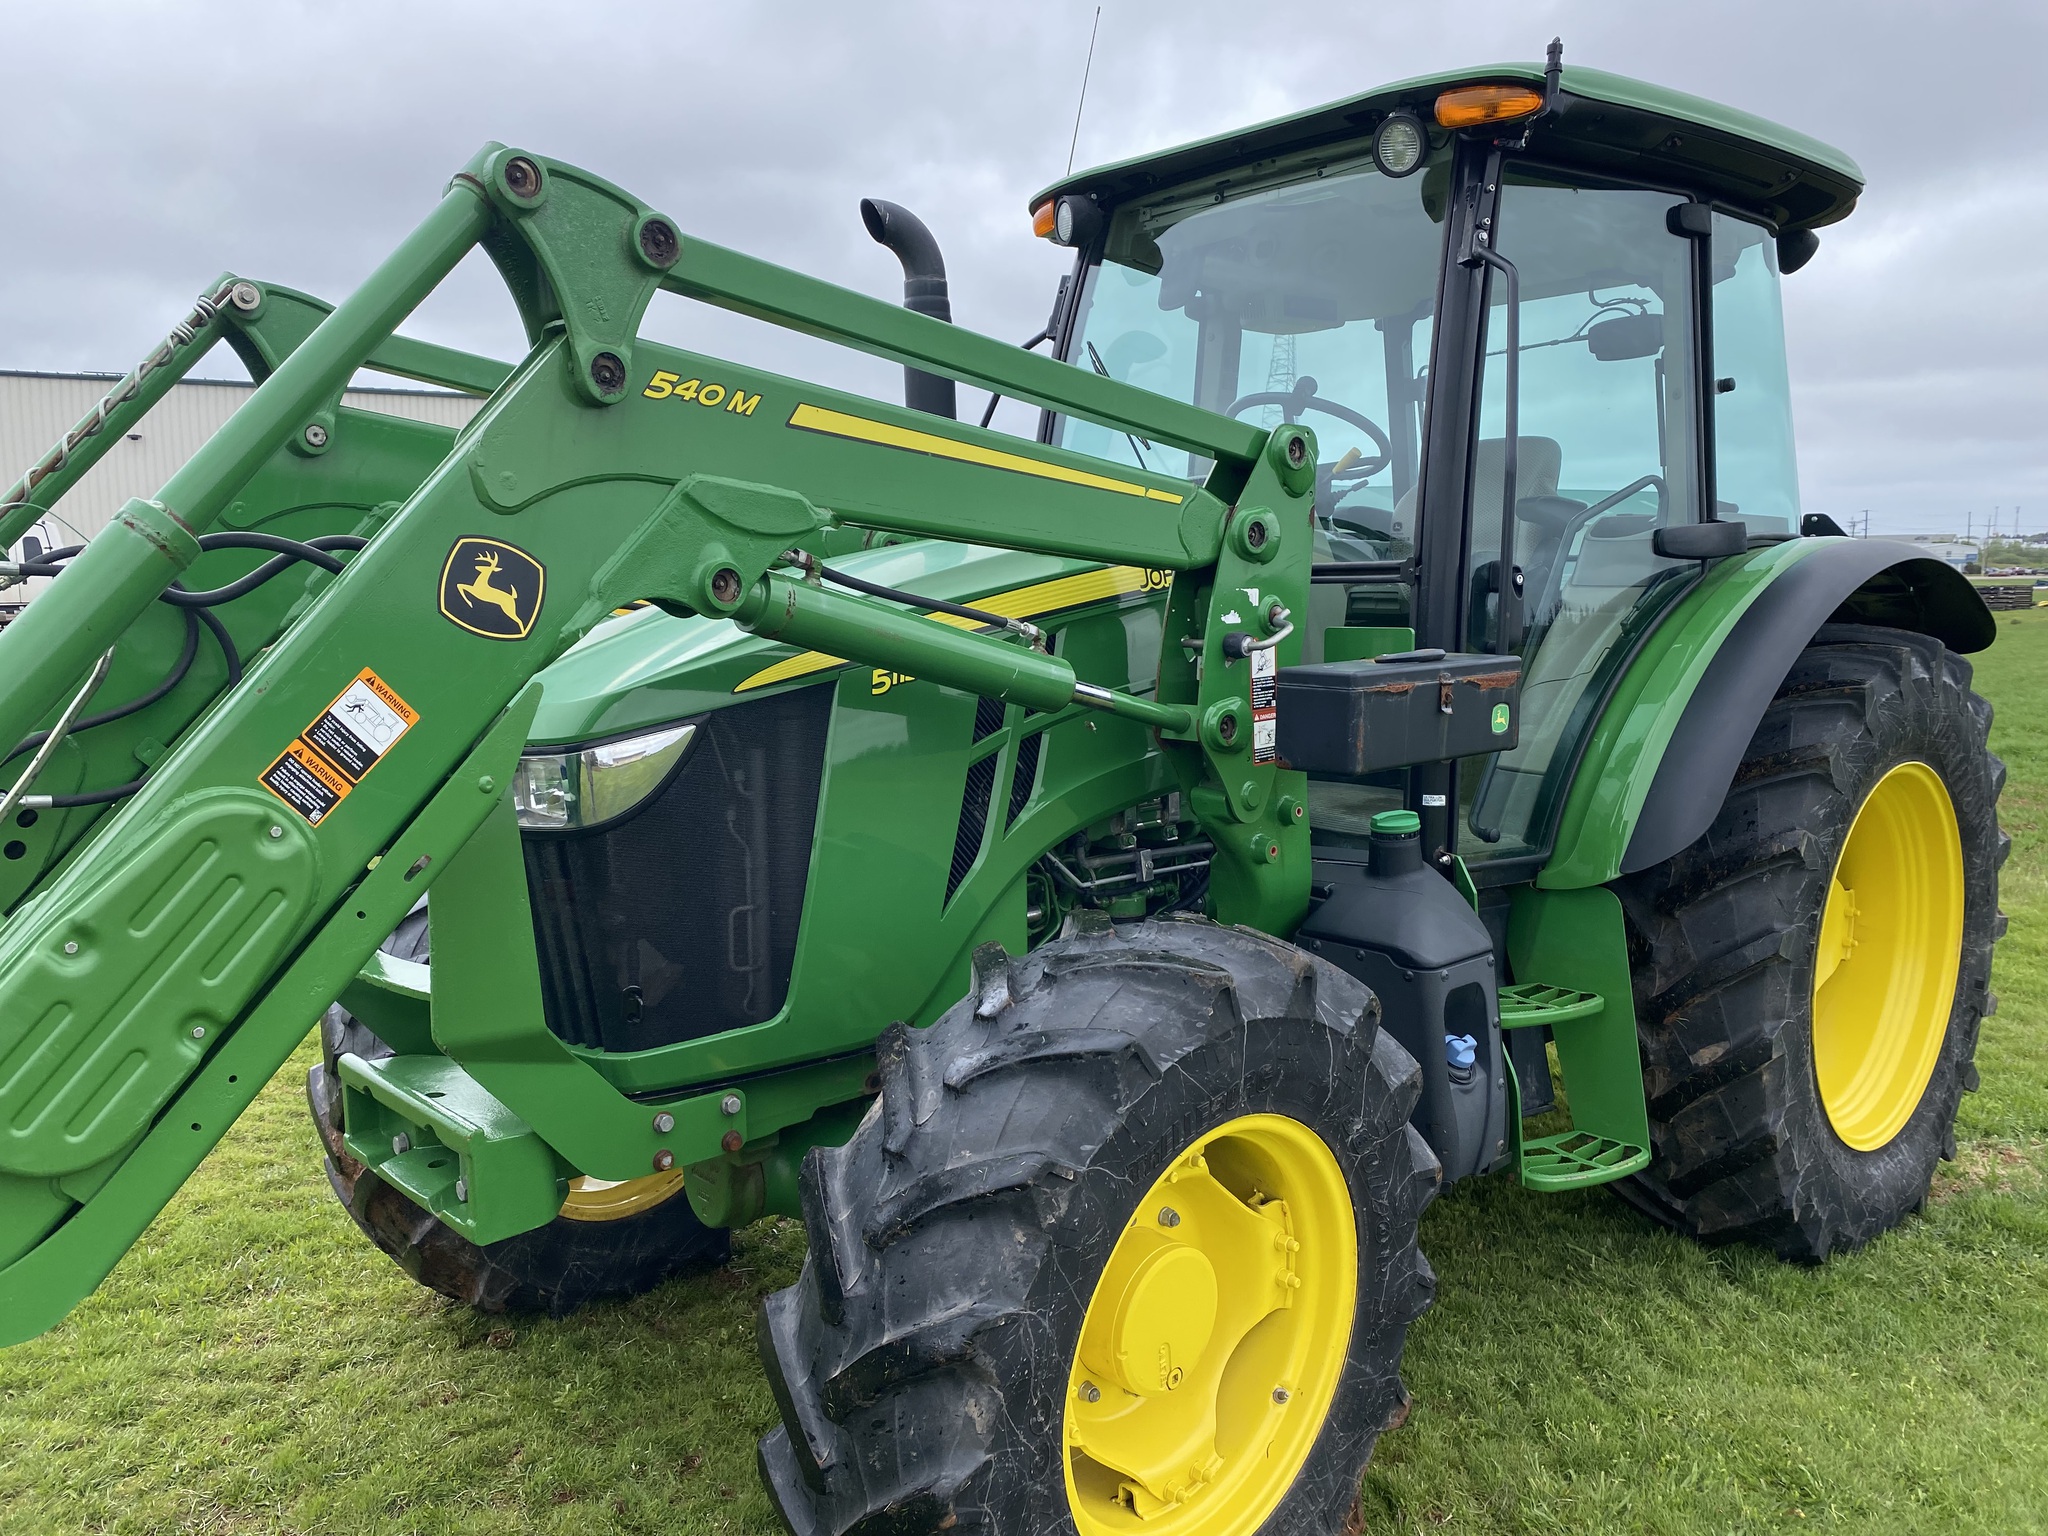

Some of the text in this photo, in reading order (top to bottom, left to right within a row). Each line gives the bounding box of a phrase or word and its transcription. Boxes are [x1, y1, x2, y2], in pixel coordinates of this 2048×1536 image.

[375, 683, 411, 719] WARNING
[1260, 712, 1276, 720] DANGER
[306, 756, 343, 791] WARNING
